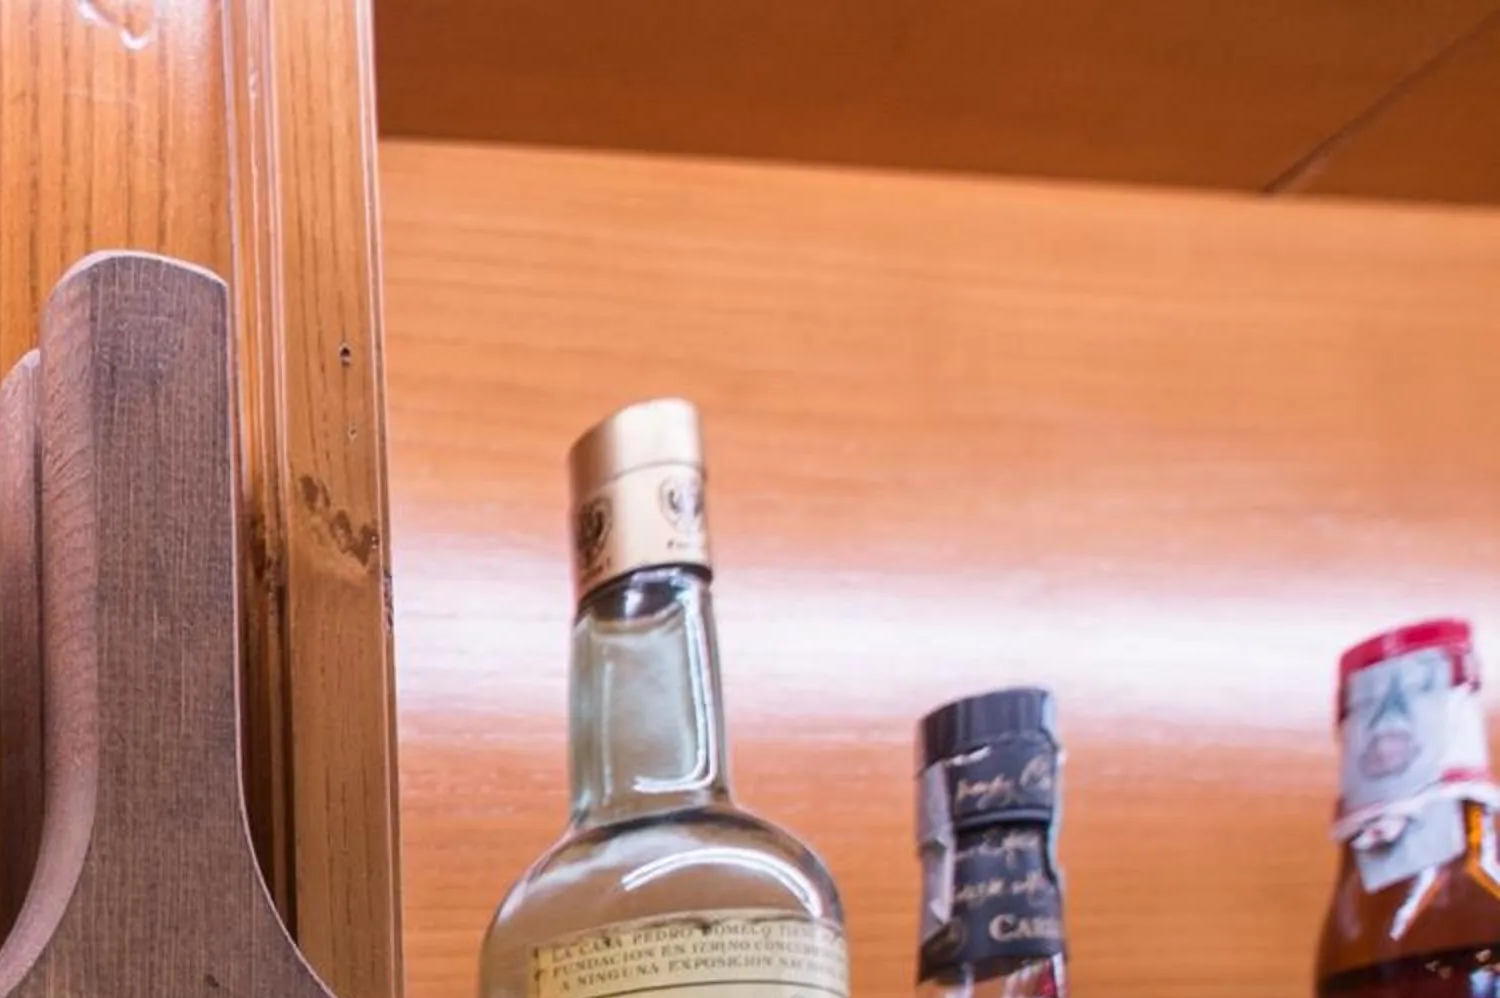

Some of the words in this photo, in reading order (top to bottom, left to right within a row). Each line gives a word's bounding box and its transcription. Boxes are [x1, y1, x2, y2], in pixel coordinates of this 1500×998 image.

[632, 926, 693, 946] PEDRO
[702, 922, 772, 940] OMECQ
[553, 947, 655, 978] FUNDACION
[577, 962, 659, 986] NINGUNA
